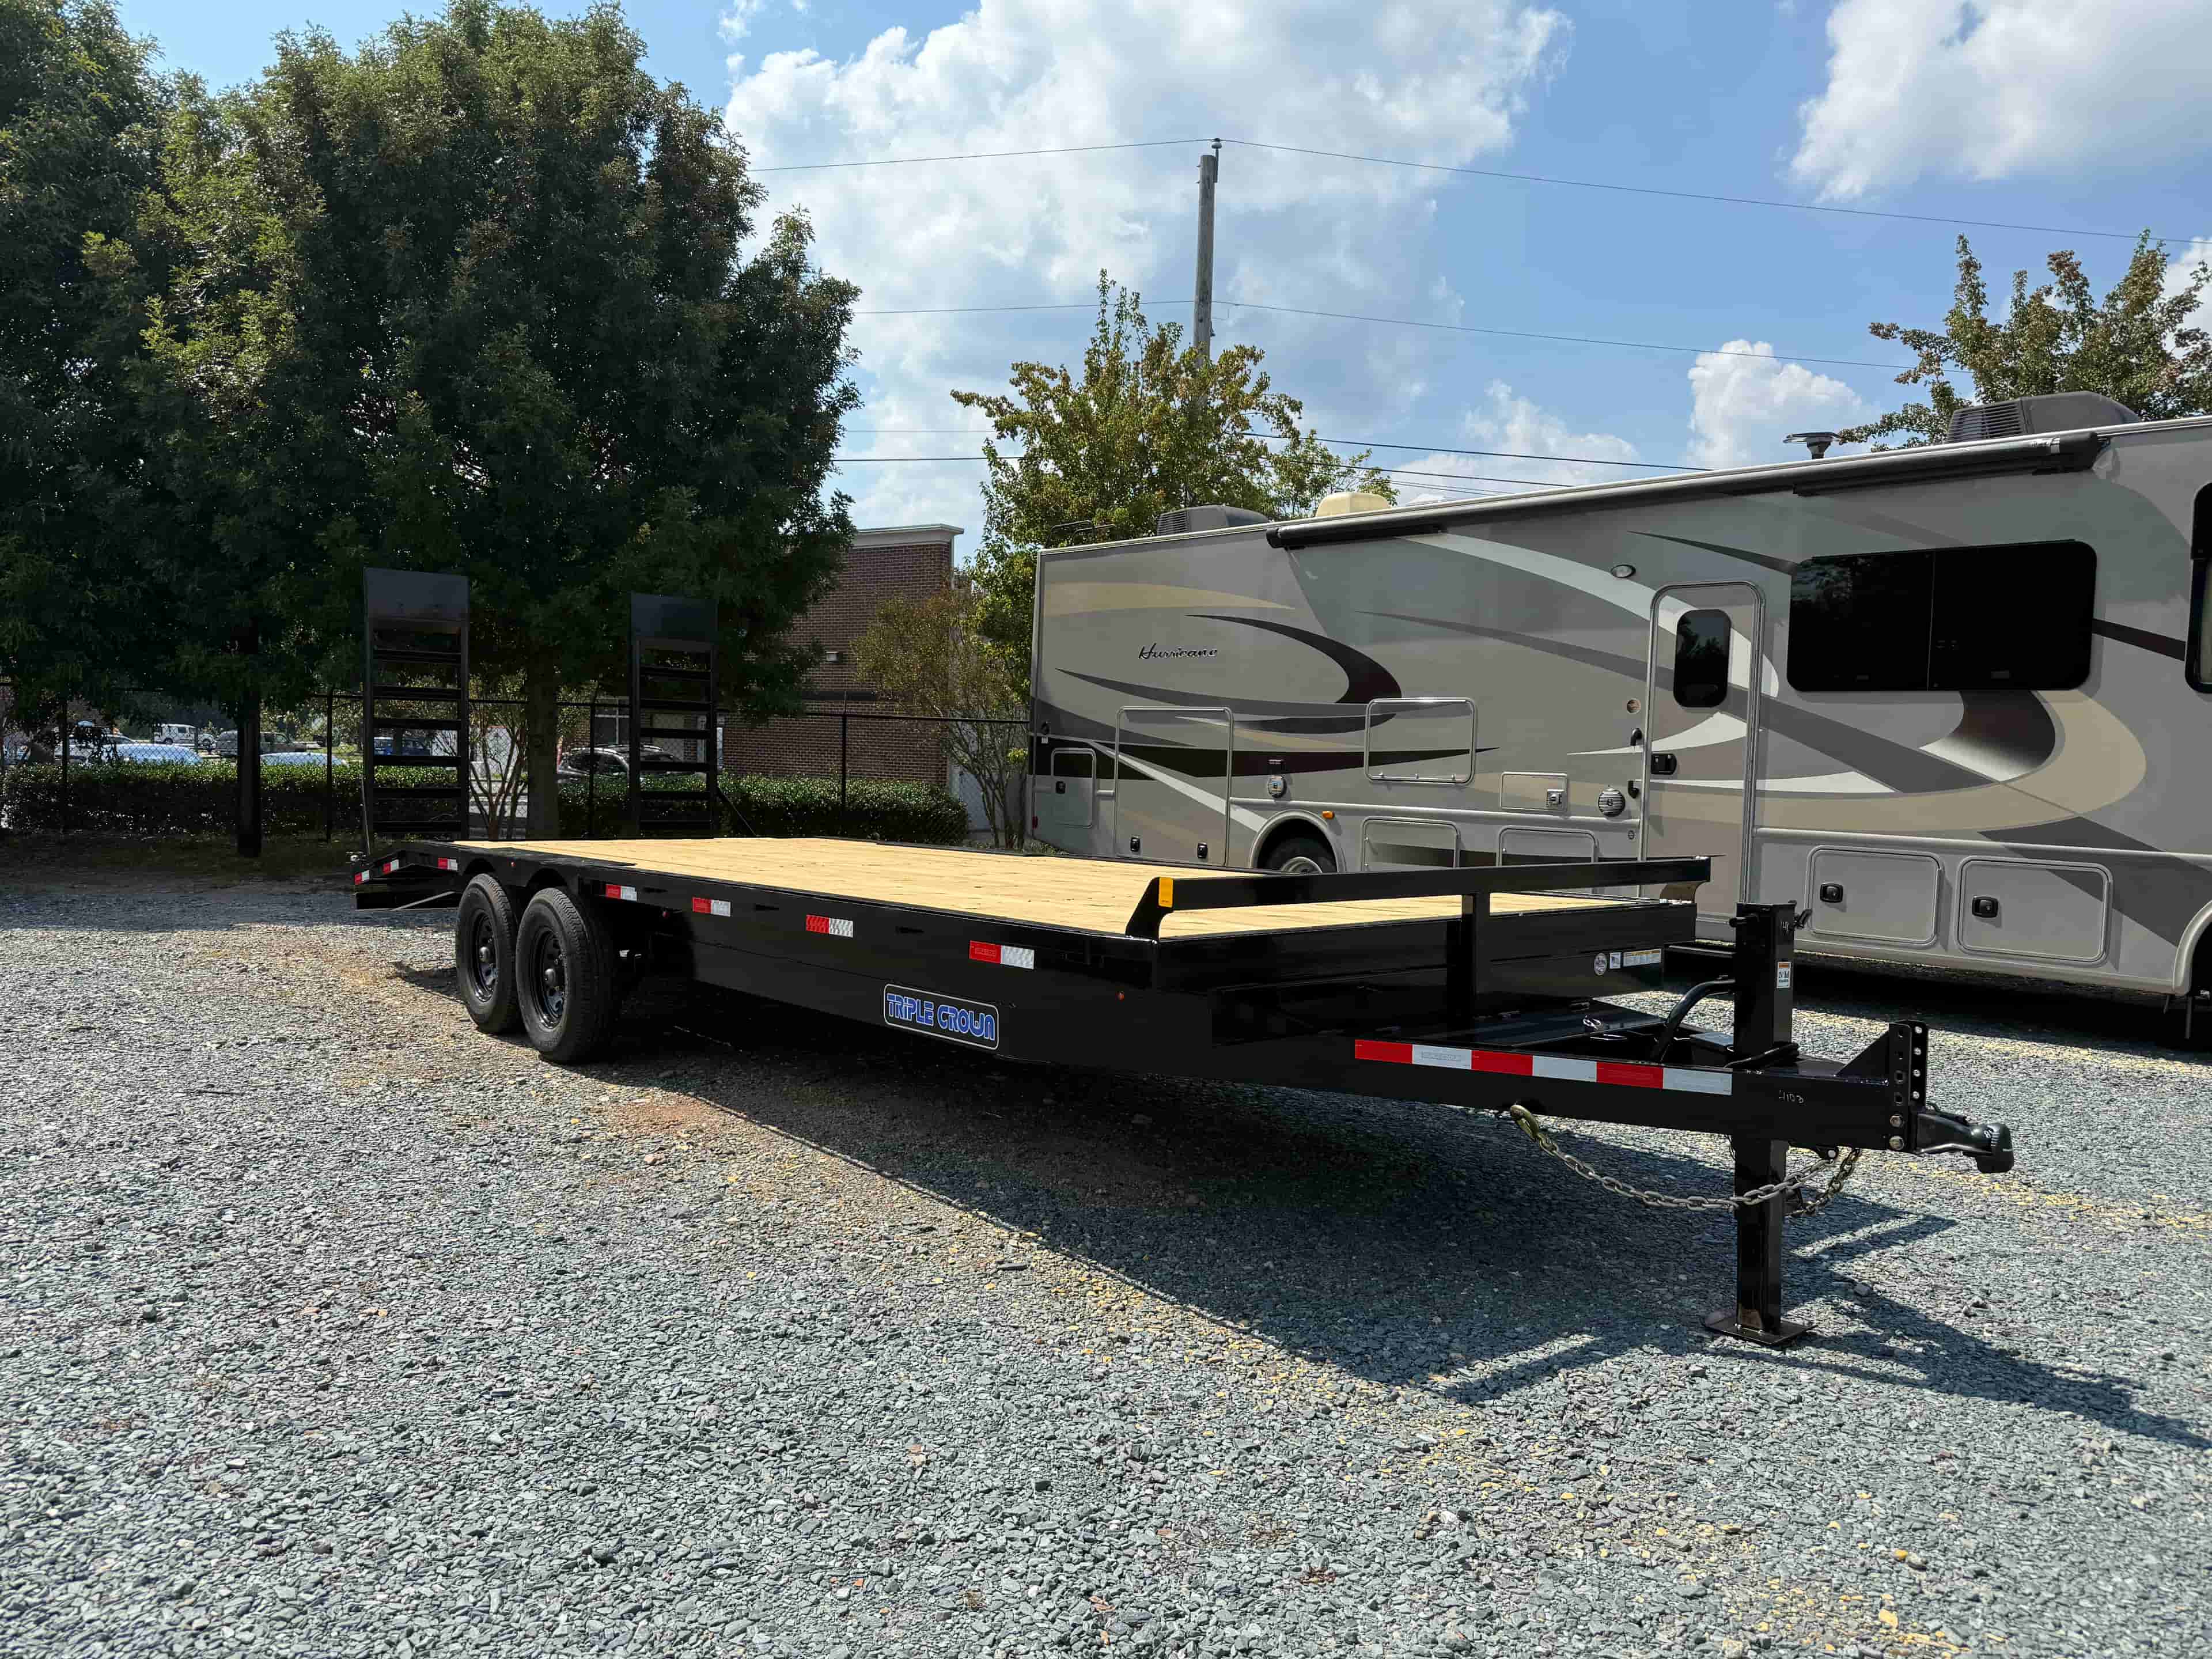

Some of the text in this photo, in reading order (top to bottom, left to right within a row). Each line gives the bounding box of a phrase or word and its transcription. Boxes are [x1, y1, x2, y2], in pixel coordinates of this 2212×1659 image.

[1138, 642, 1217, 659] Hurricane
[887, 993, 995, 1040] TRIPLE CROWN
